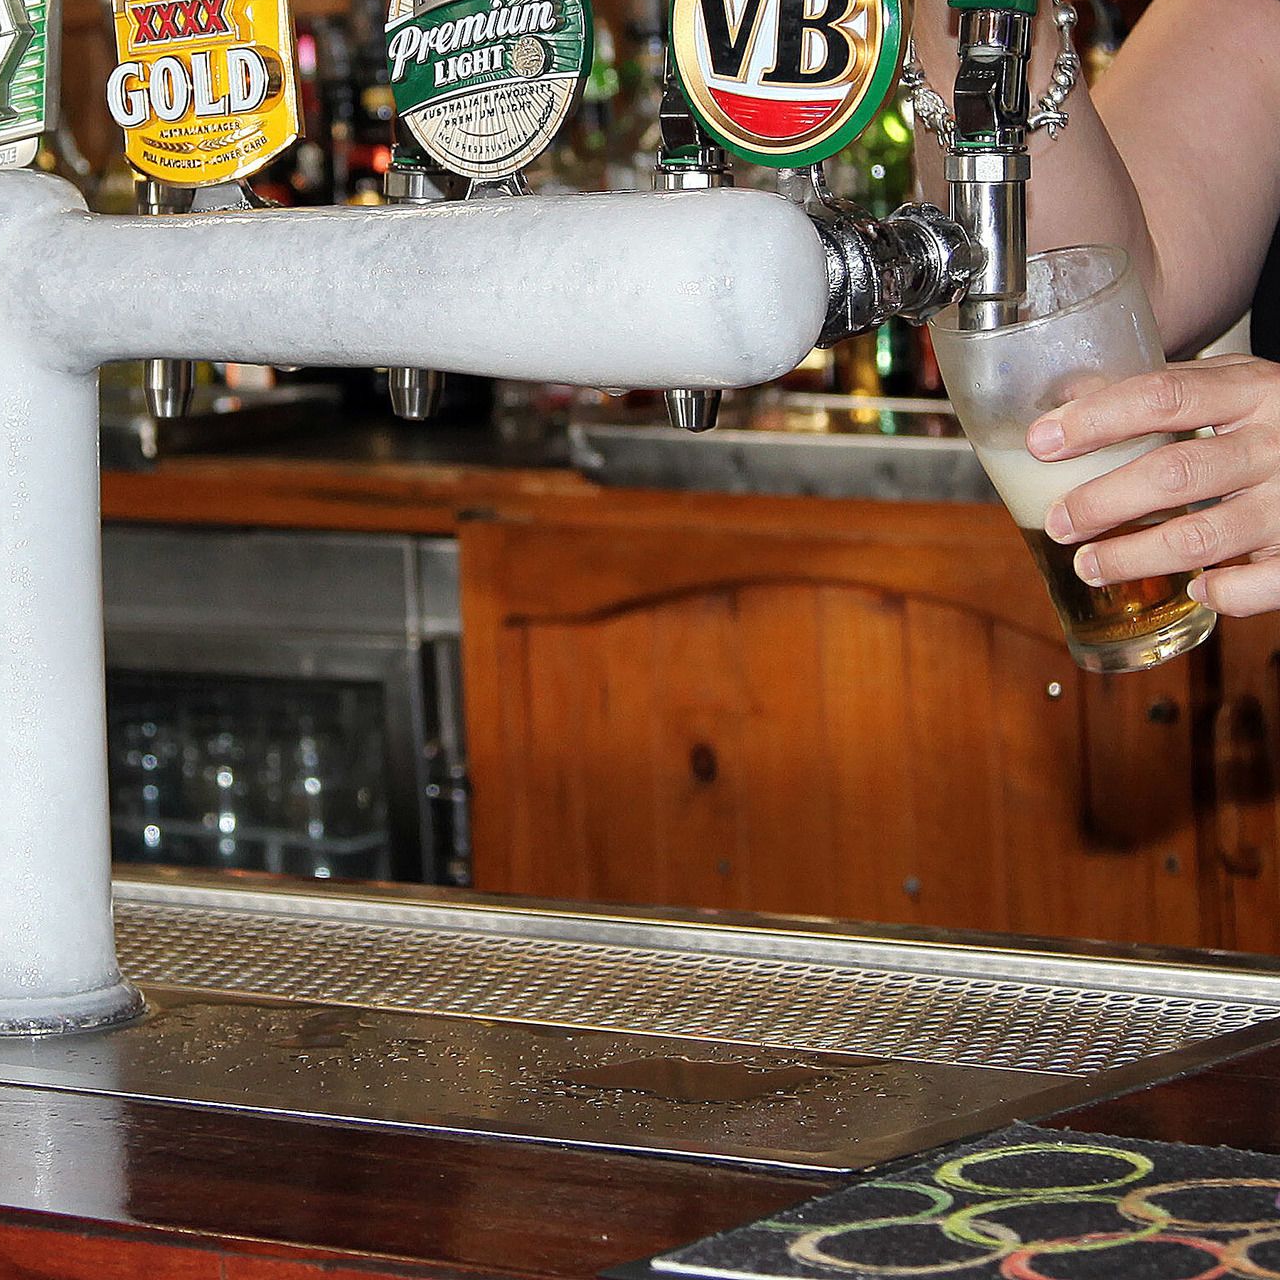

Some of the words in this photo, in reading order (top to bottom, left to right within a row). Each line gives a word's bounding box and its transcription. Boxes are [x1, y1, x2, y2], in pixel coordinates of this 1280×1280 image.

[434, 44, 506, 87] LIGHT
[107, 48, 270, 128] GOLD
[244, 136, 268, 154] CARB
